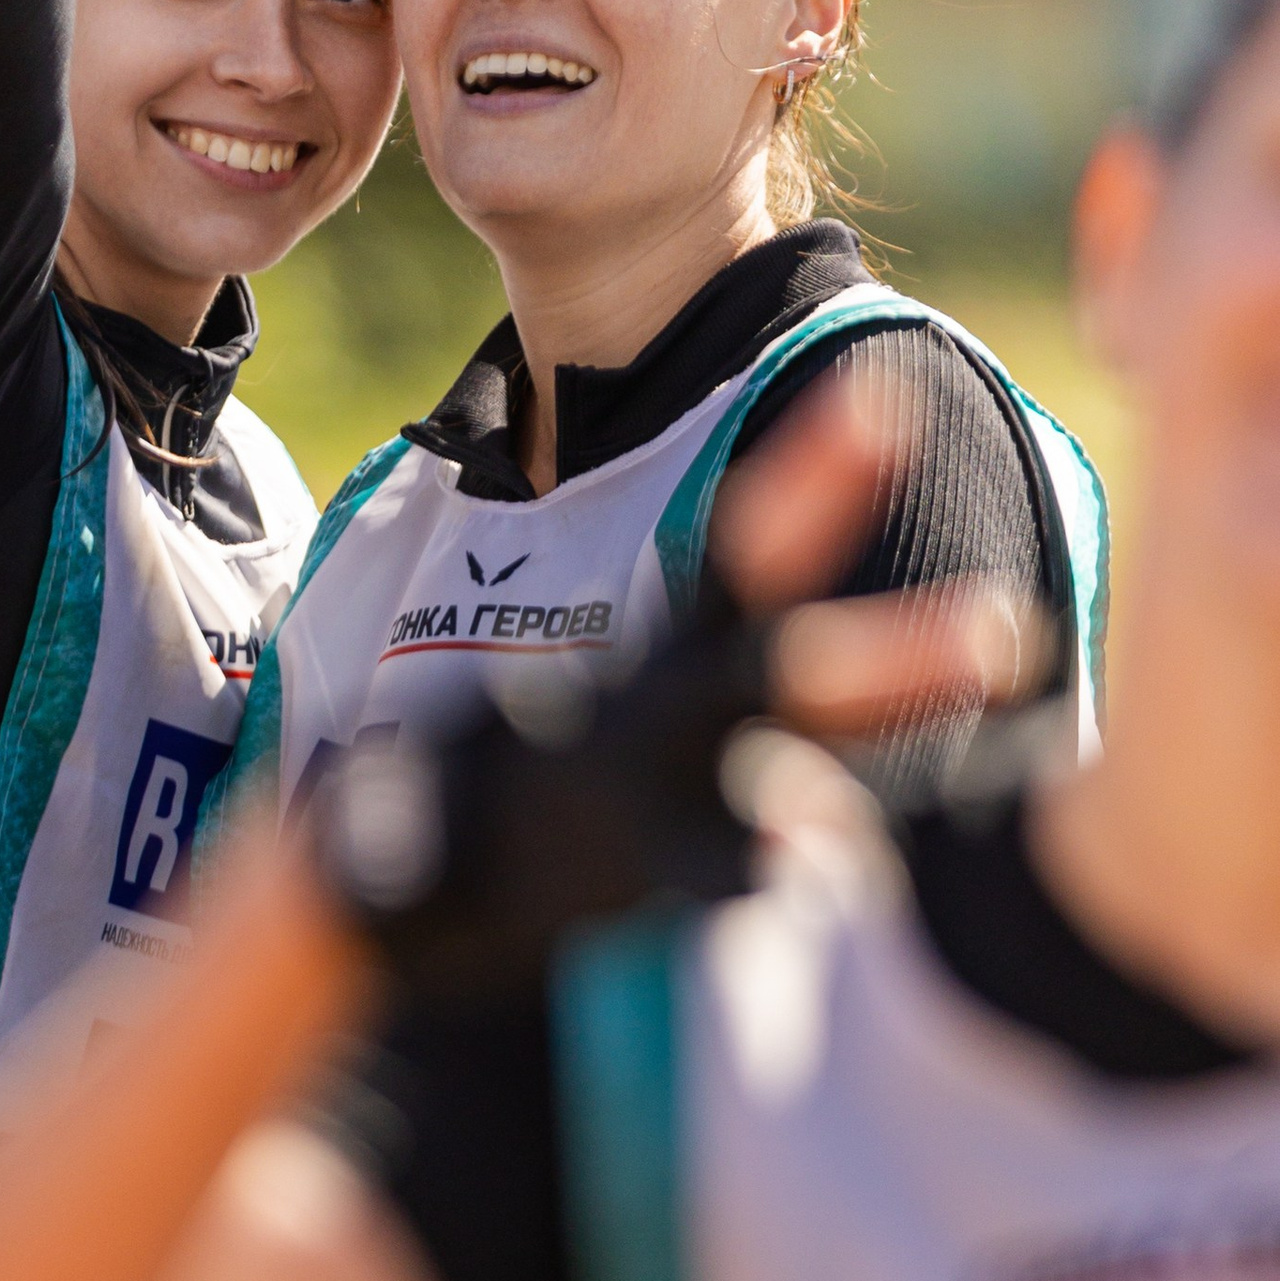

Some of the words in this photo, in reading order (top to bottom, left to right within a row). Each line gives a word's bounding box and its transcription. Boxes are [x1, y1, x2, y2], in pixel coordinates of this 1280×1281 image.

[388, 604, 458, 646] ОНКА
[468, 600, 613, 639] ГЕРОЕВ
[123, 753, 189, 893] R
